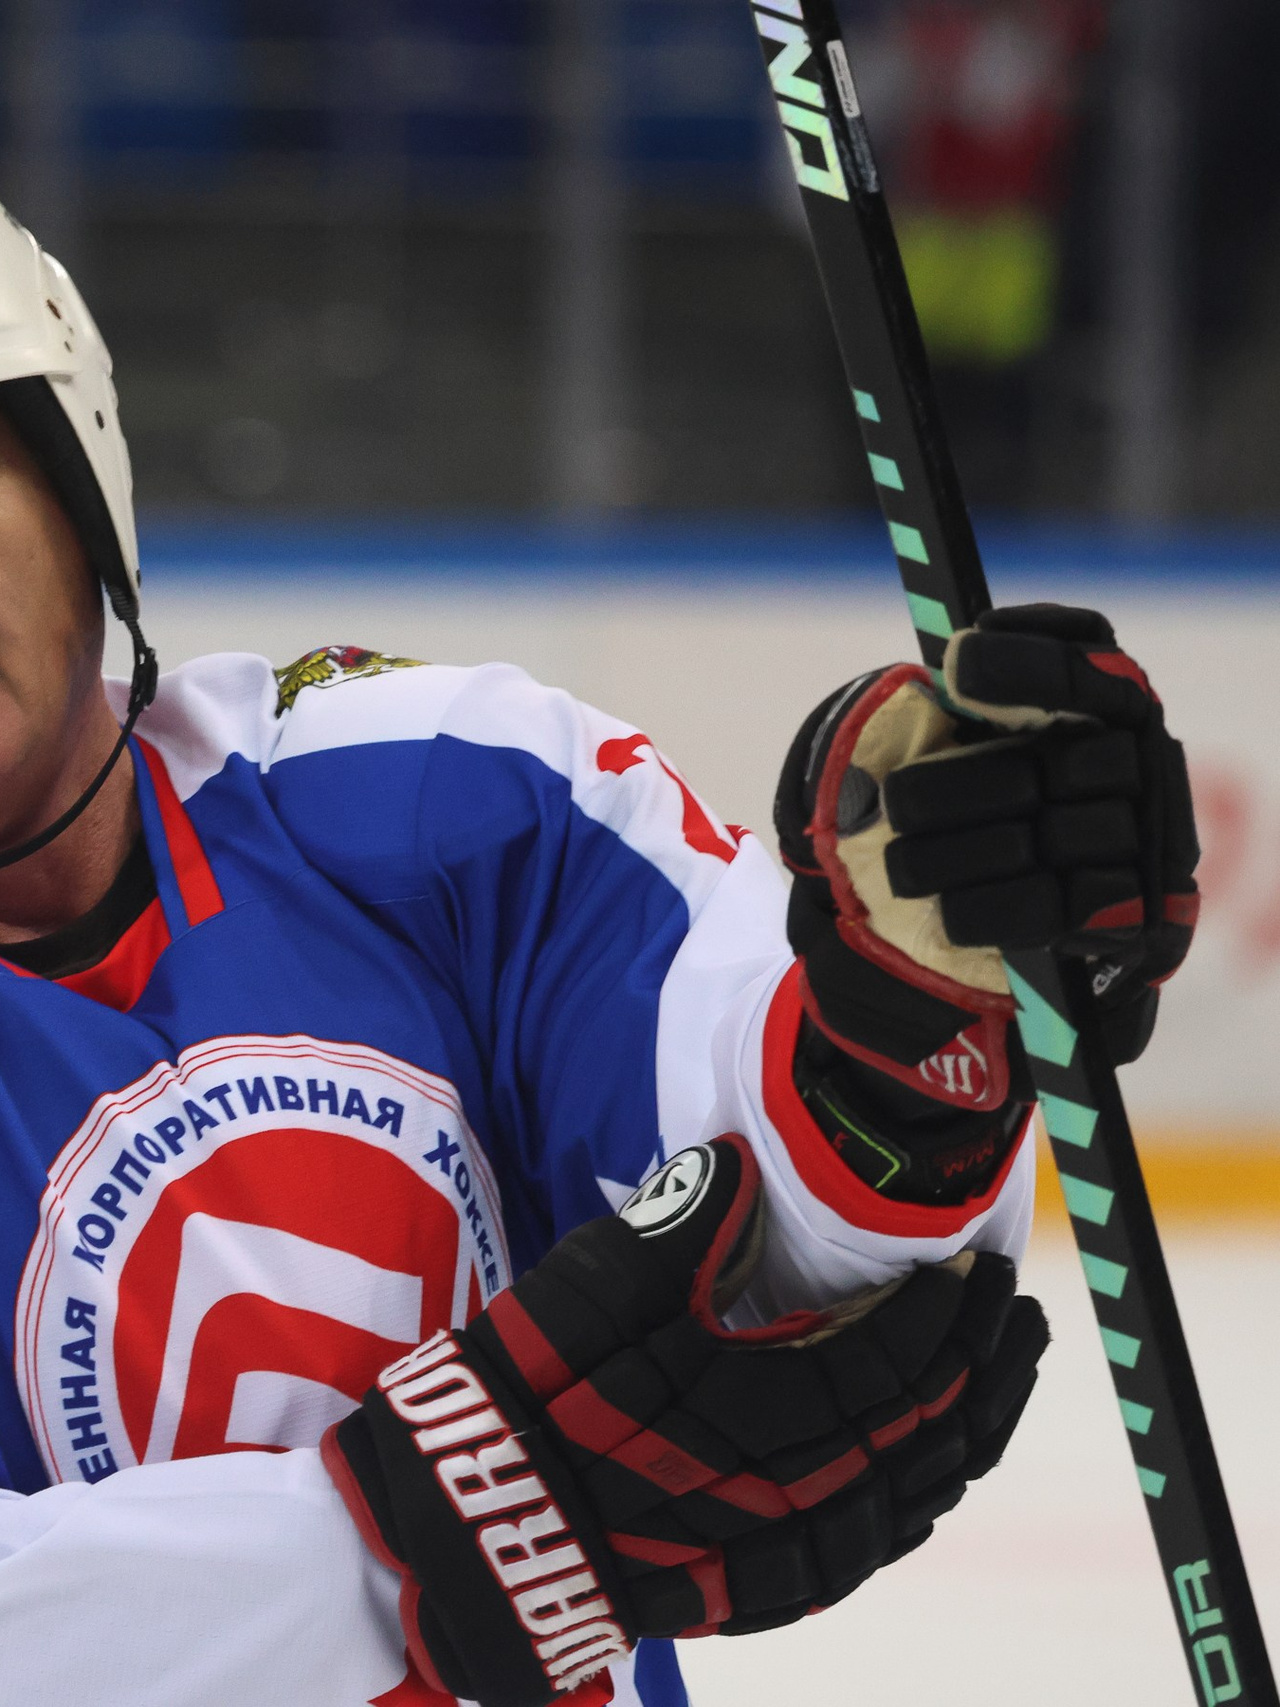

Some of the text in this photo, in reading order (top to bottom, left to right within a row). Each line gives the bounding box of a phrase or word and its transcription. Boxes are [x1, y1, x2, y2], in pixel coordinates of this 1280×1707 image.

[60, 1075, 500, 1486] ЕННАЯ КОРПОРАТИВНАЯ ХОККЕ
[376, 1328, 630, 1694] WARRIOR
